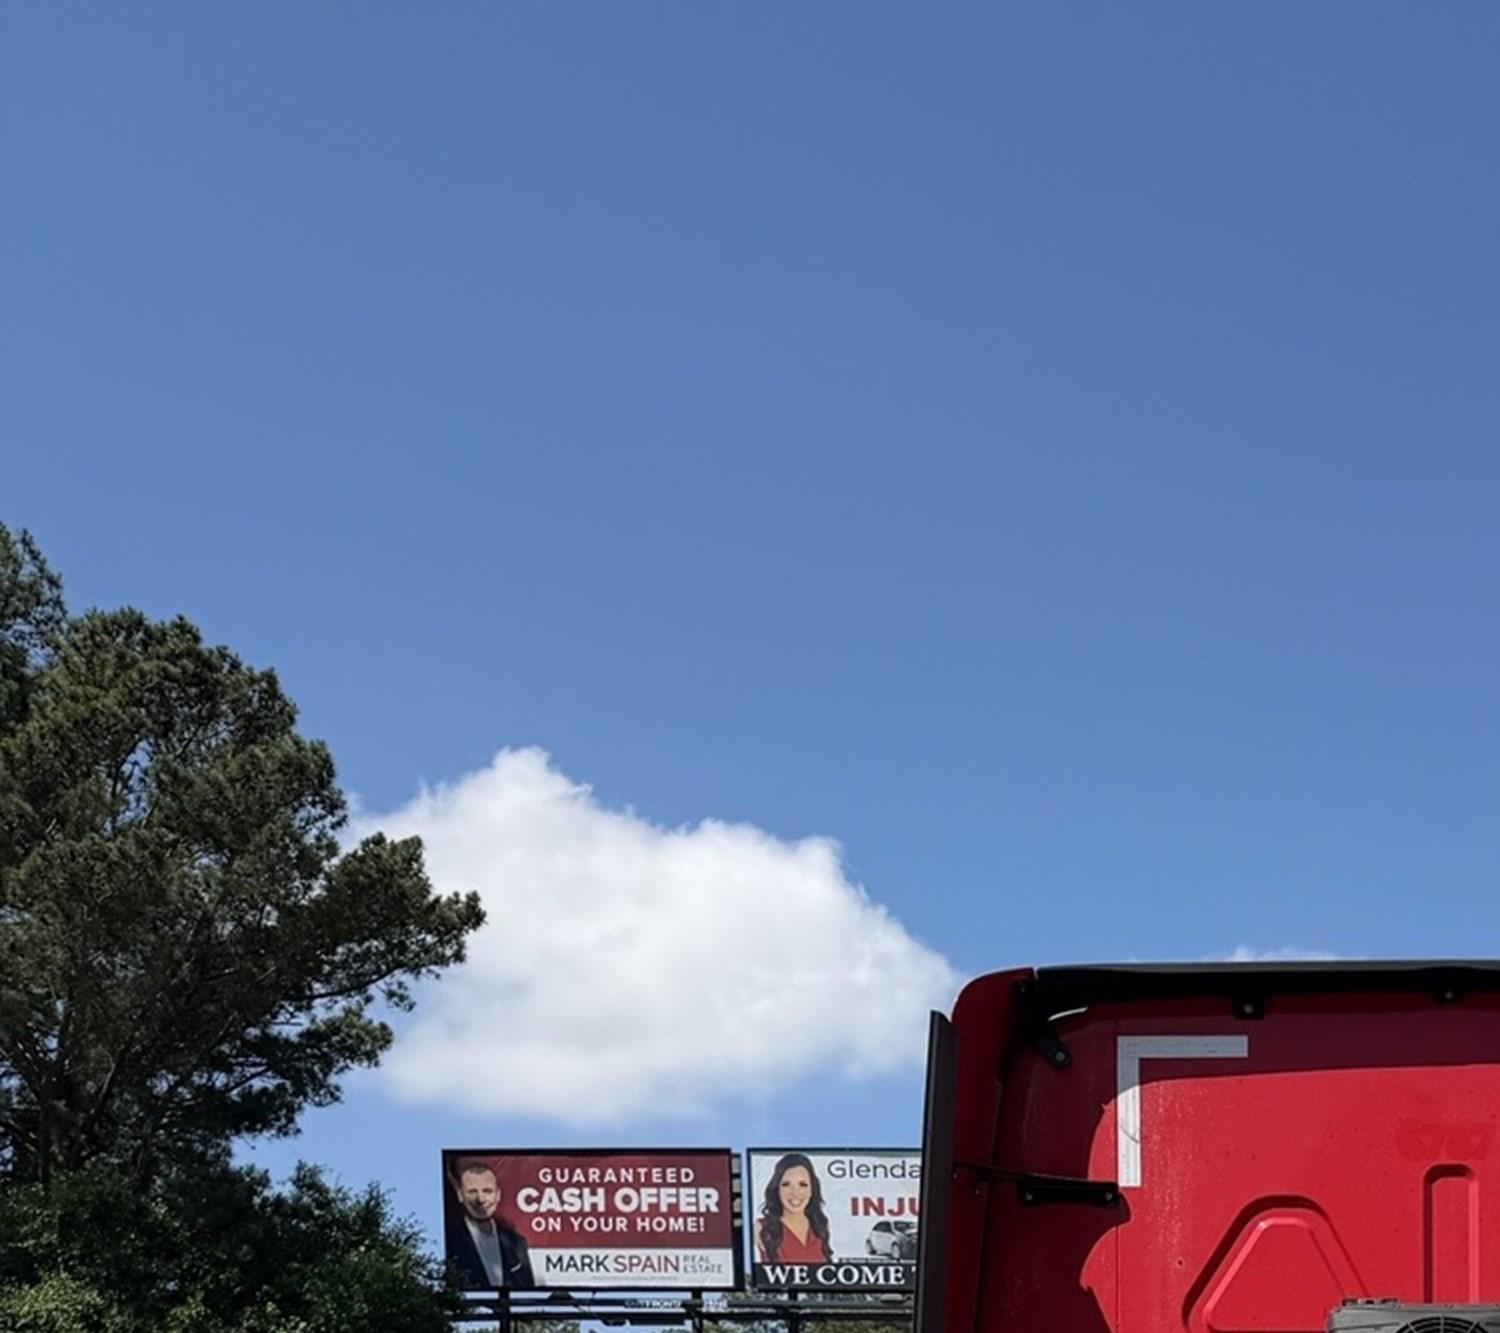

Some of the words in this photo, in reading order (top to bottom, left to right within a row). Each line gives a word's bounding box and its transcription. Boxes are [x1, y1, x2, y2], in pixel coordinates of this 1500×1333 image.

[539, 1168, 695, 1183] GUARANTEED
[827, 1159, 921, 1179] Glenda
[516, 1187, 606, 1213] CASH
[613, 1187, 720, 1213] OFFER
[531, 1217, 562, 1232] ON
[570, 1217, 629, 1232] YOUR
[636, 1217, 705, 1232] HOME!
[545, 1254, 611, 1273] MARK
[613, 1254, 680, 1273] SPAIN
[684, 1255, 710, 1264] REAL
[683, 1264, 723, 1275] ESTATE
[763, 1265, 810, 1286] WE
[815, 1265, 906, 1286] COME
